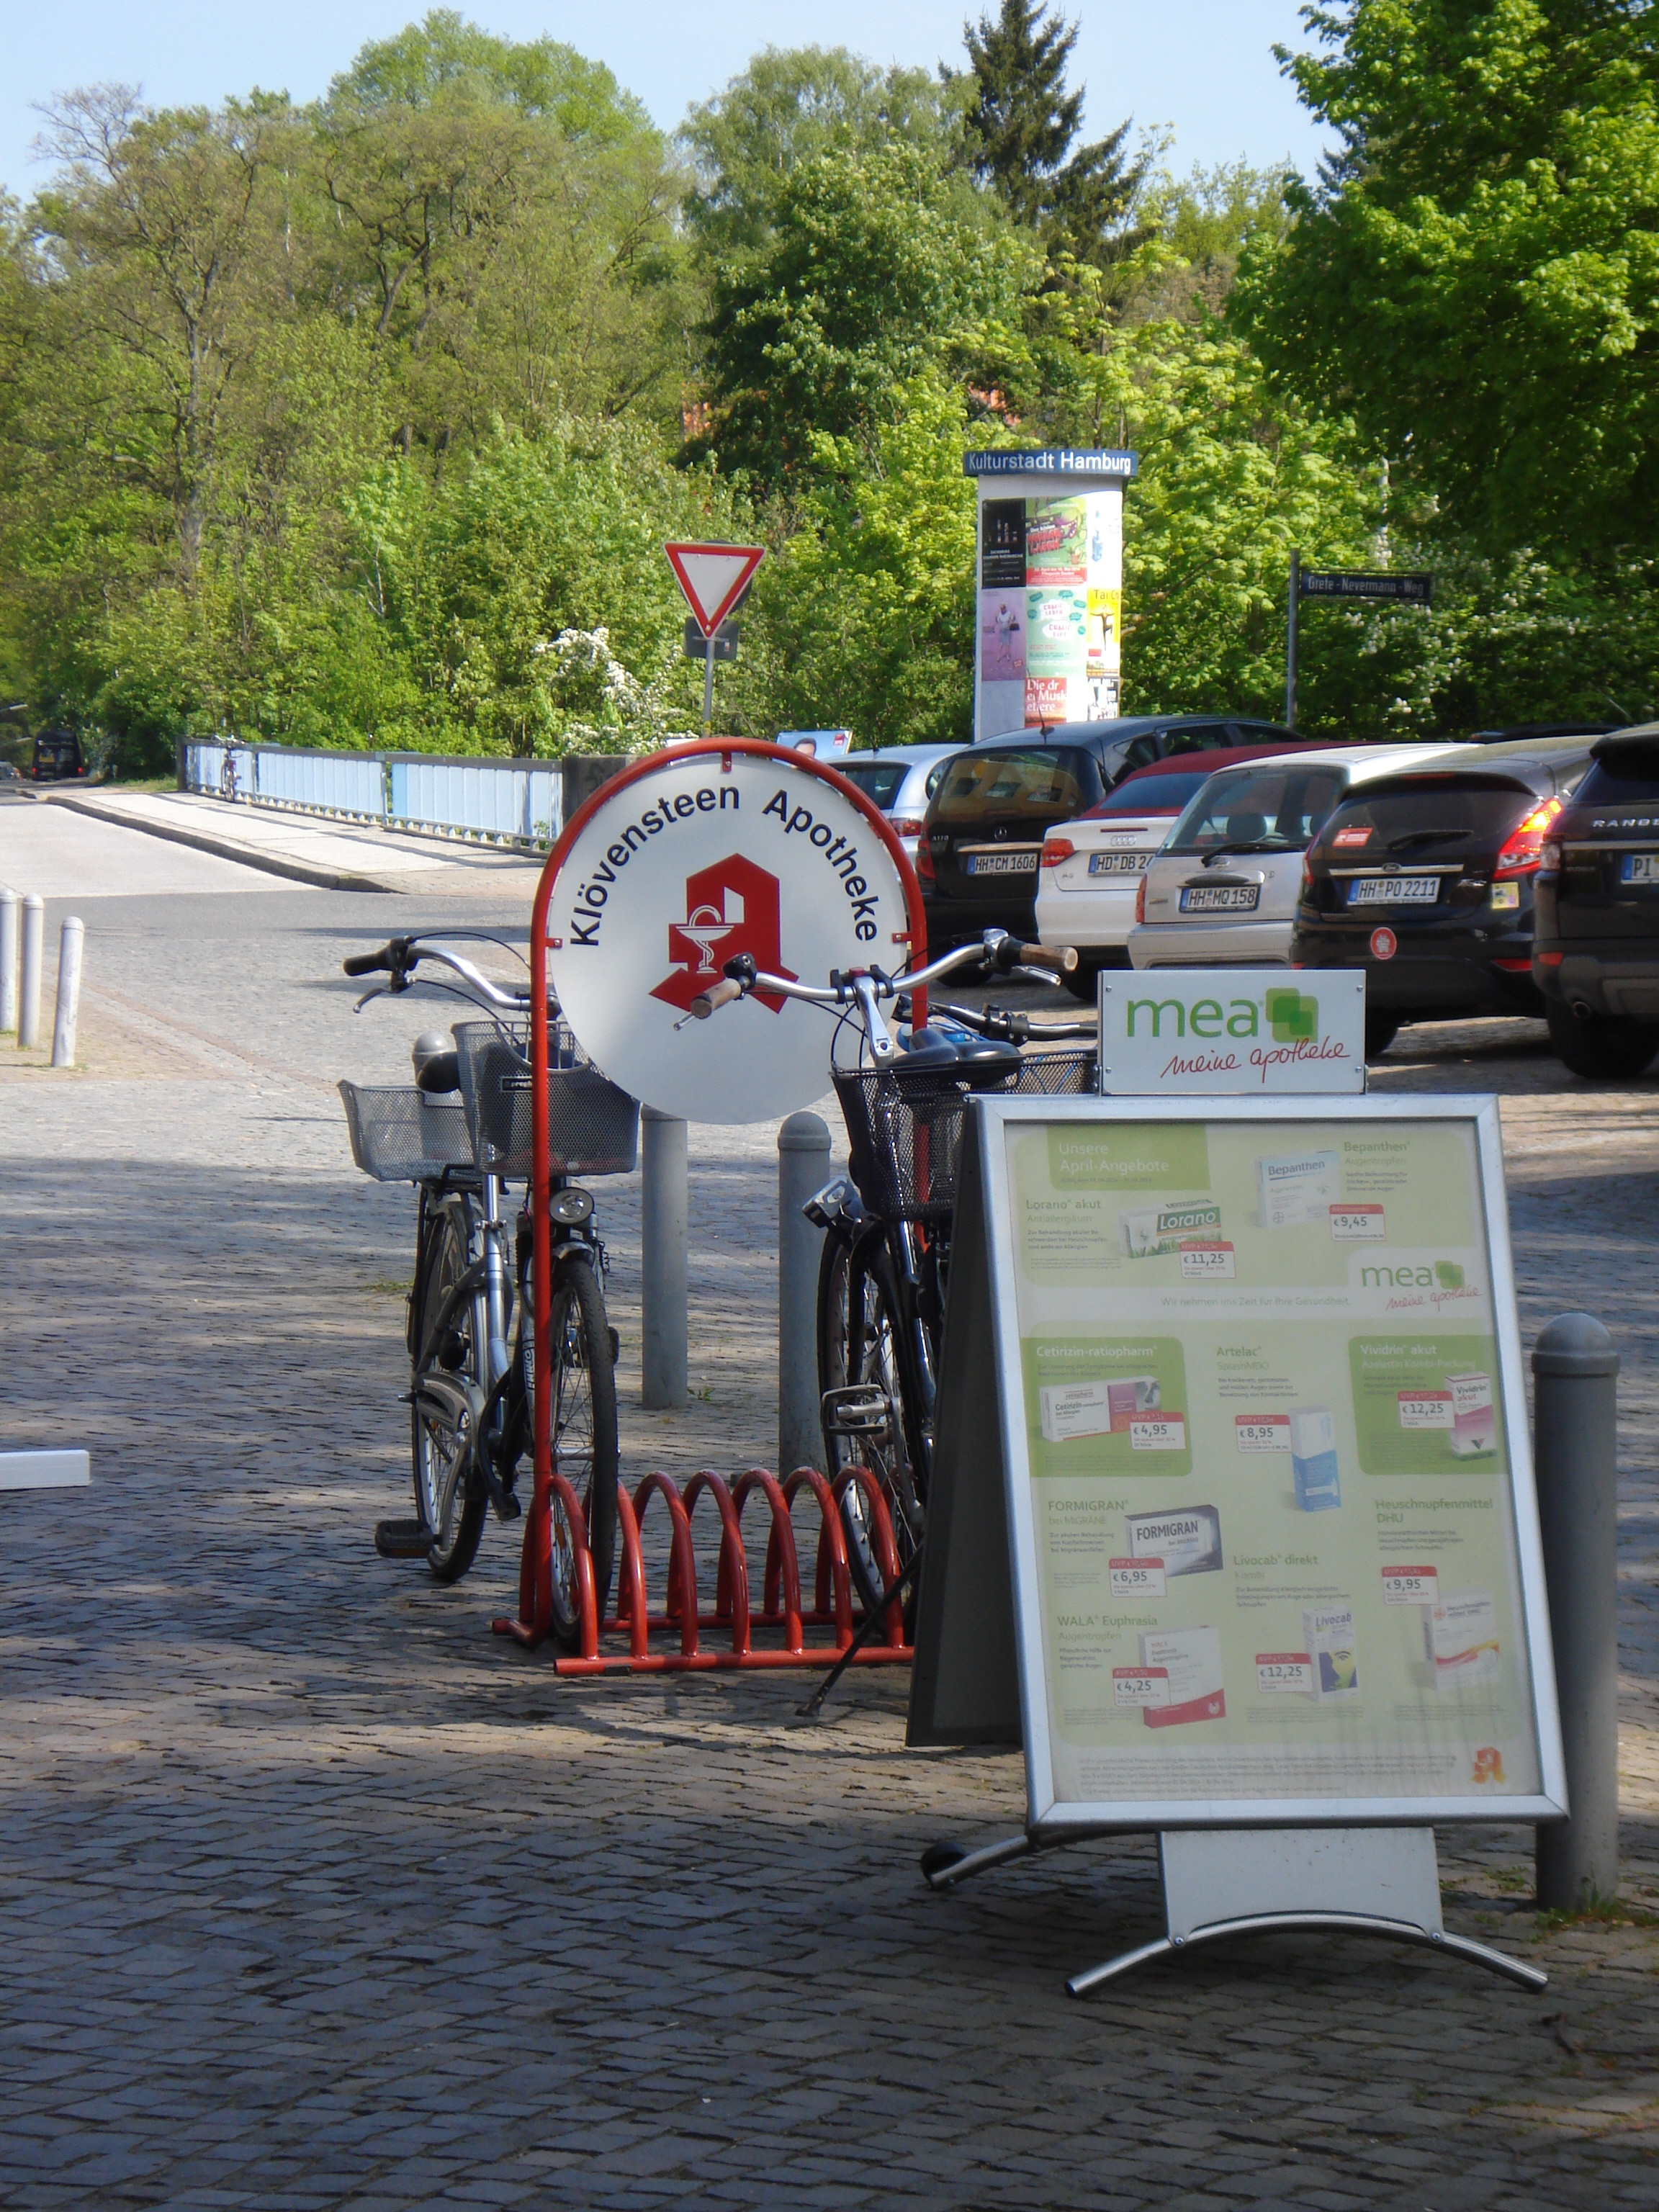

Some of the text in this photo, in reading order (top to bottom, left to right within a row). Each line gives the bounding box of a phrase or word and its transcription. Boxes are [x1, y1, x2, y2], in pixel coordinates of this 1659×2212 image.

[969, 451, 1131, 475] Kulturstadt Hamburg
[1093, 590, 1108, 600] Tai
[1028, 679, 1059, 691] Die dr
[1038, 689, 1066, 701] Musk
[570, 786, 879, 946] Klövensteen Apotheke
[976, 855, 1035, 871] HH CM 1606
[1097, 856, 1112, 870] HD
[1120, 855, 1136, 870] DB
[1633, 858, 1650, 876] PI
[1359, 881, 1377, 899] HH
[1403, 880, 1437, 896] 2211
[1189, 888, 1256, 906] HH MQ 158
[1160, 1035, 1351, 1084] meine apotheke
[1058, 1143, 1109, 1155] Unsere
[1059, 1159, 1169, 1176] April-Angebote
[1268, 1160, 1326, 1177] Bepanthen
[1075, 1199, 1102, 1210] akut
[1027, 1213, 1092, 1224] Antiallergikum
[1159, 1210, 1216, 1230] Lorano
[1341, 1215, 1367, 1229] 9,45
[1191, 1253, 1225, 1267] 11,25
[1161, 1297, 1178, 1306] Wir
[1179, 1297, 1218, 1306] nehmen
[1238, 1297, 1257, 1306] Zeit
[1410, 1344, 1437, 1355] akut
[1409, 1403, 1444, 1416] 12,25
[1141, 1424, 1167, 1437] 4,95
[1247, 1427, 1274, 1440] 8,95
[1375, 1498, 1493, 1511] Heuschnupfenmittel
[1048, 1515, 1062, 1524] bei
[1376, 1513, 1403, 1524] DHU
[1136, 1519, 1199, 1541] FORMIGRAN
[1284, 1554, 1318, 1565] direkt
[1120, 1570, 1148, 1584] 6,95
[1393, 1578, 1421, 1592] 9,95
[1102, 1614, 1158, 1628] Euphrasia
[1315, 1611, 1352, 1627] Livocab
[1058, 1632, 1123, 1642] Augentropfen
[1267, 1665, 1303, 1680] 12,25
[1124, 1680, 1152, 1694] 4,25
